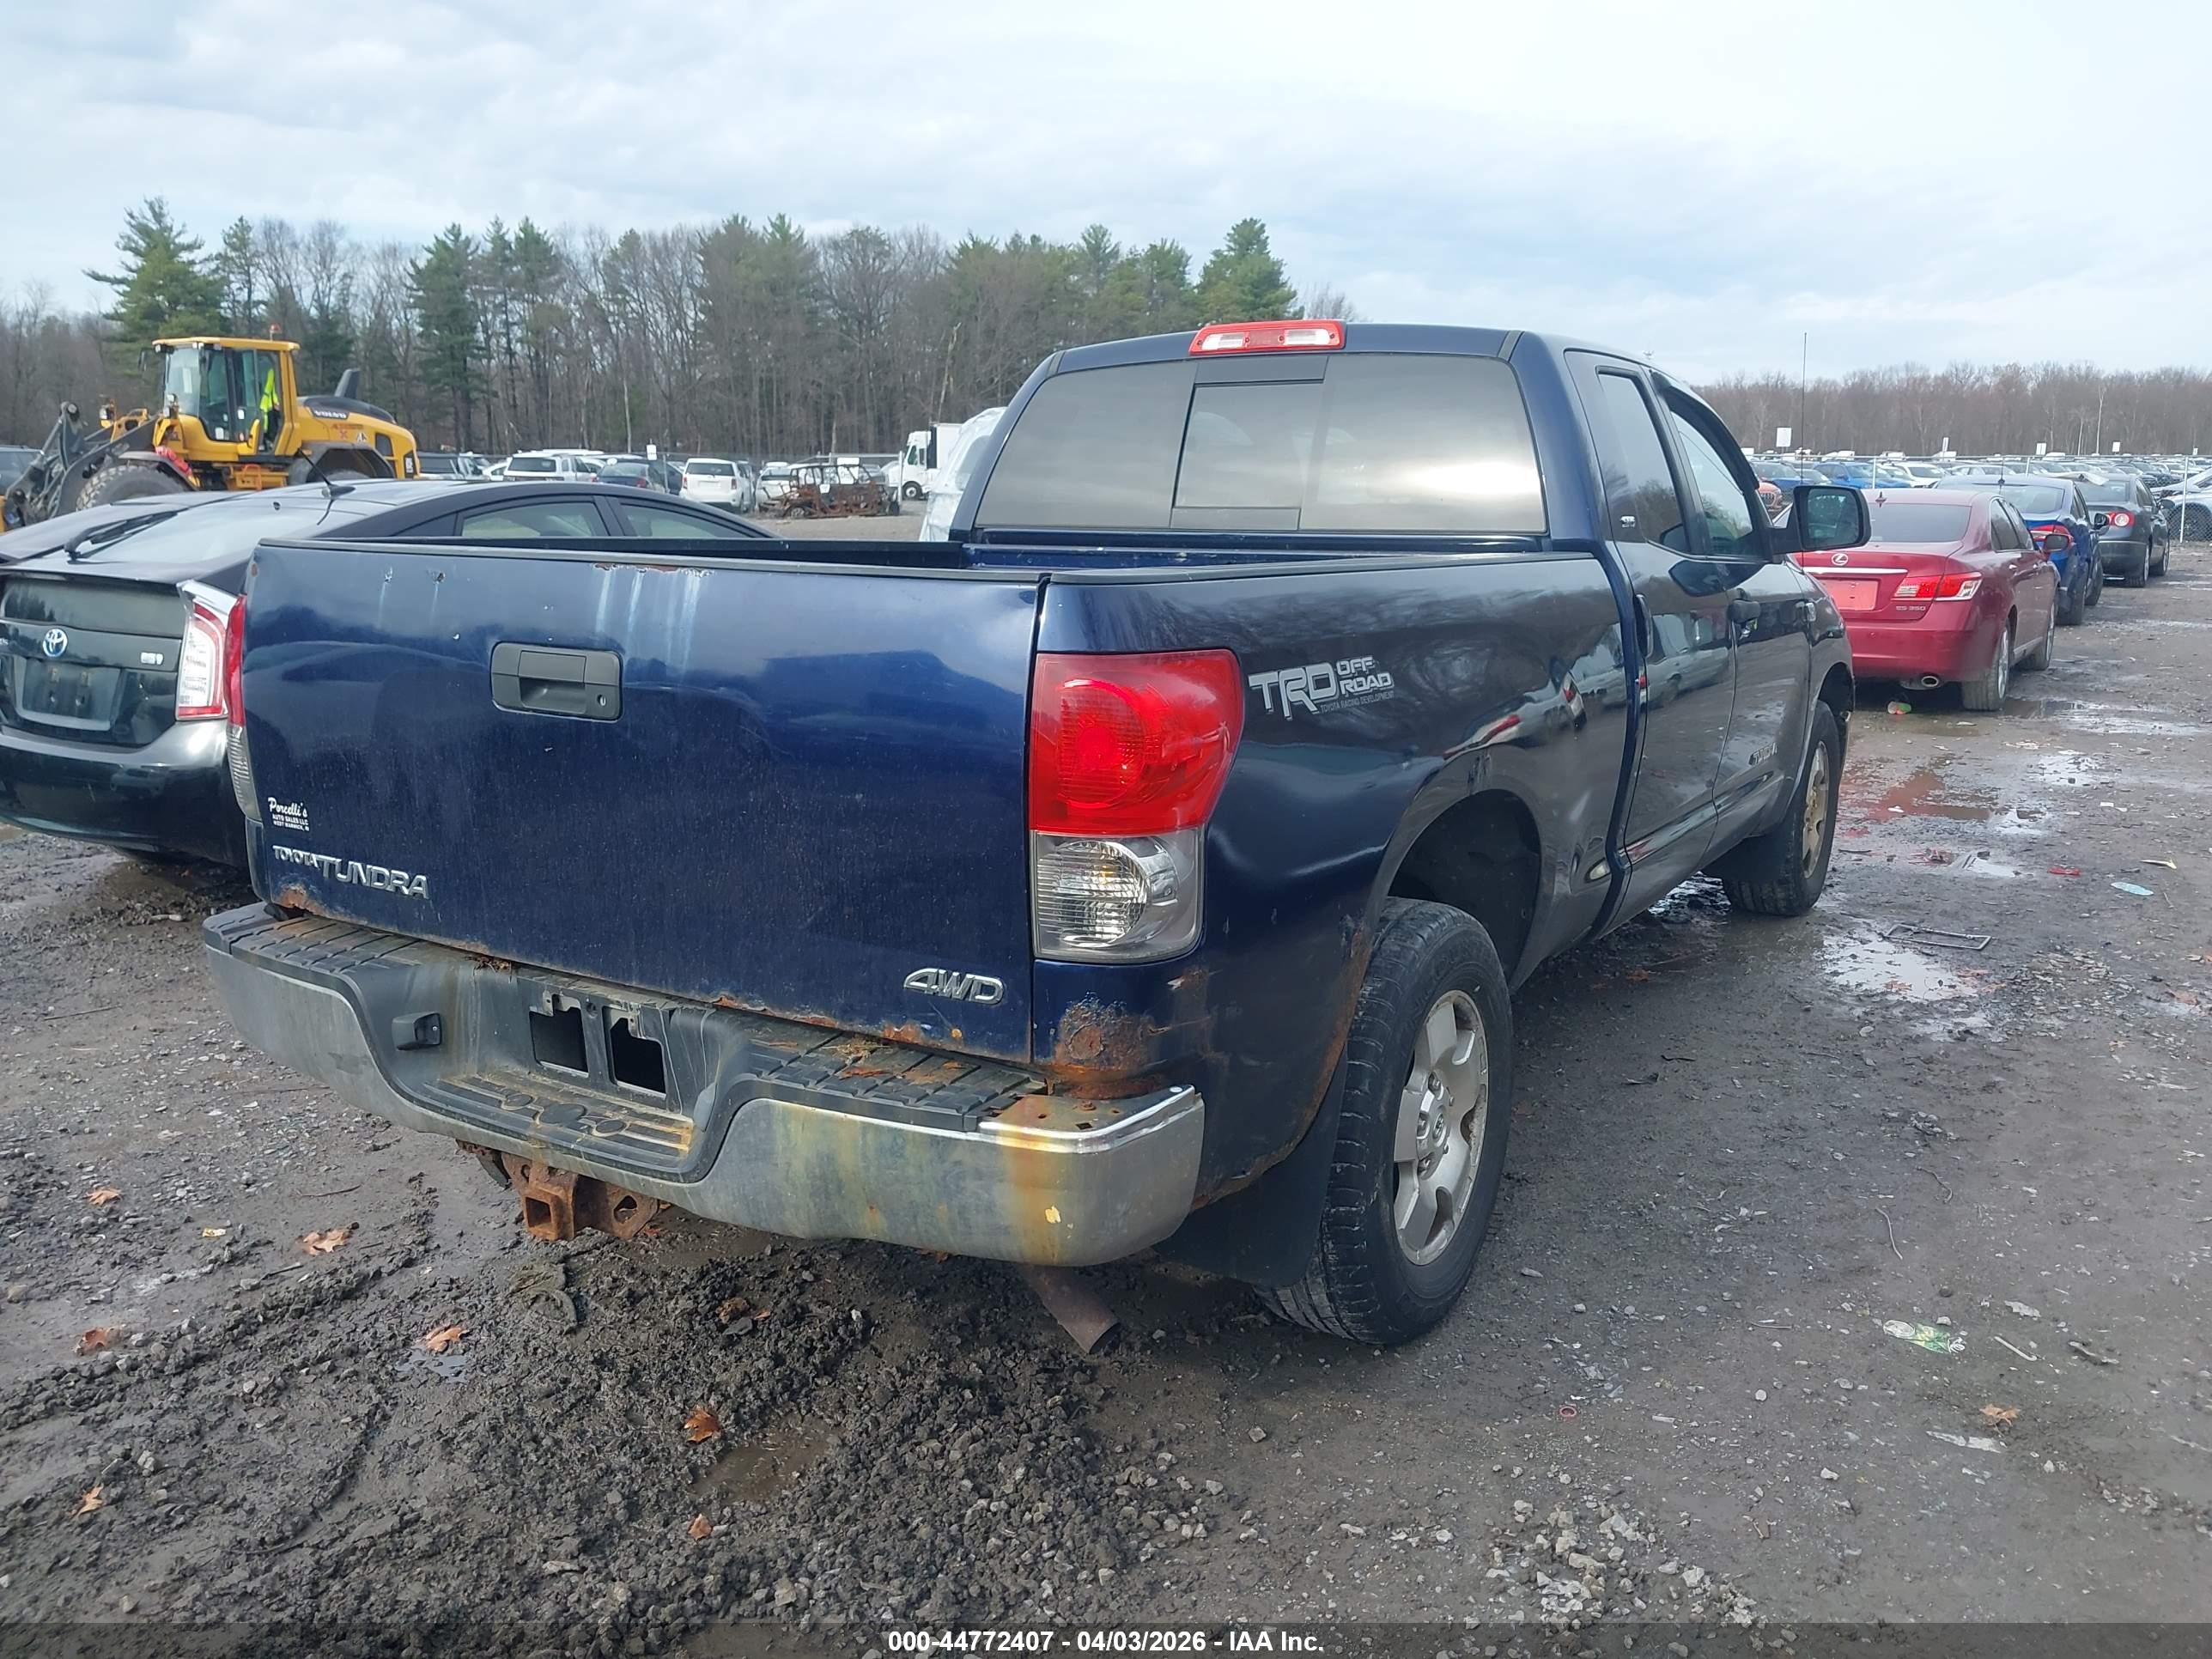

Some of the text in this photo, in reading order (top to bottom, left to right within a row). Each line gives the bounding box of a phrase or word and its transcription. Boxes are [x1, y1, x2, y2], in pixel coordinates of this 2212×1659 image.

[1336, 655, 1376, 677] OFF
[1248, 662, 1338, 721] TRD
[1340, 672, 1395, 696] ROAD
[267, 797, 308, 817] Porcelli's
[272, 813, 284, 822] AUTO
[285, 816, 299, 824] SALES
[272, 845, 430, 900] TOYOTA TUNDRA
[903, 968, 1005, 1005] 4WD
